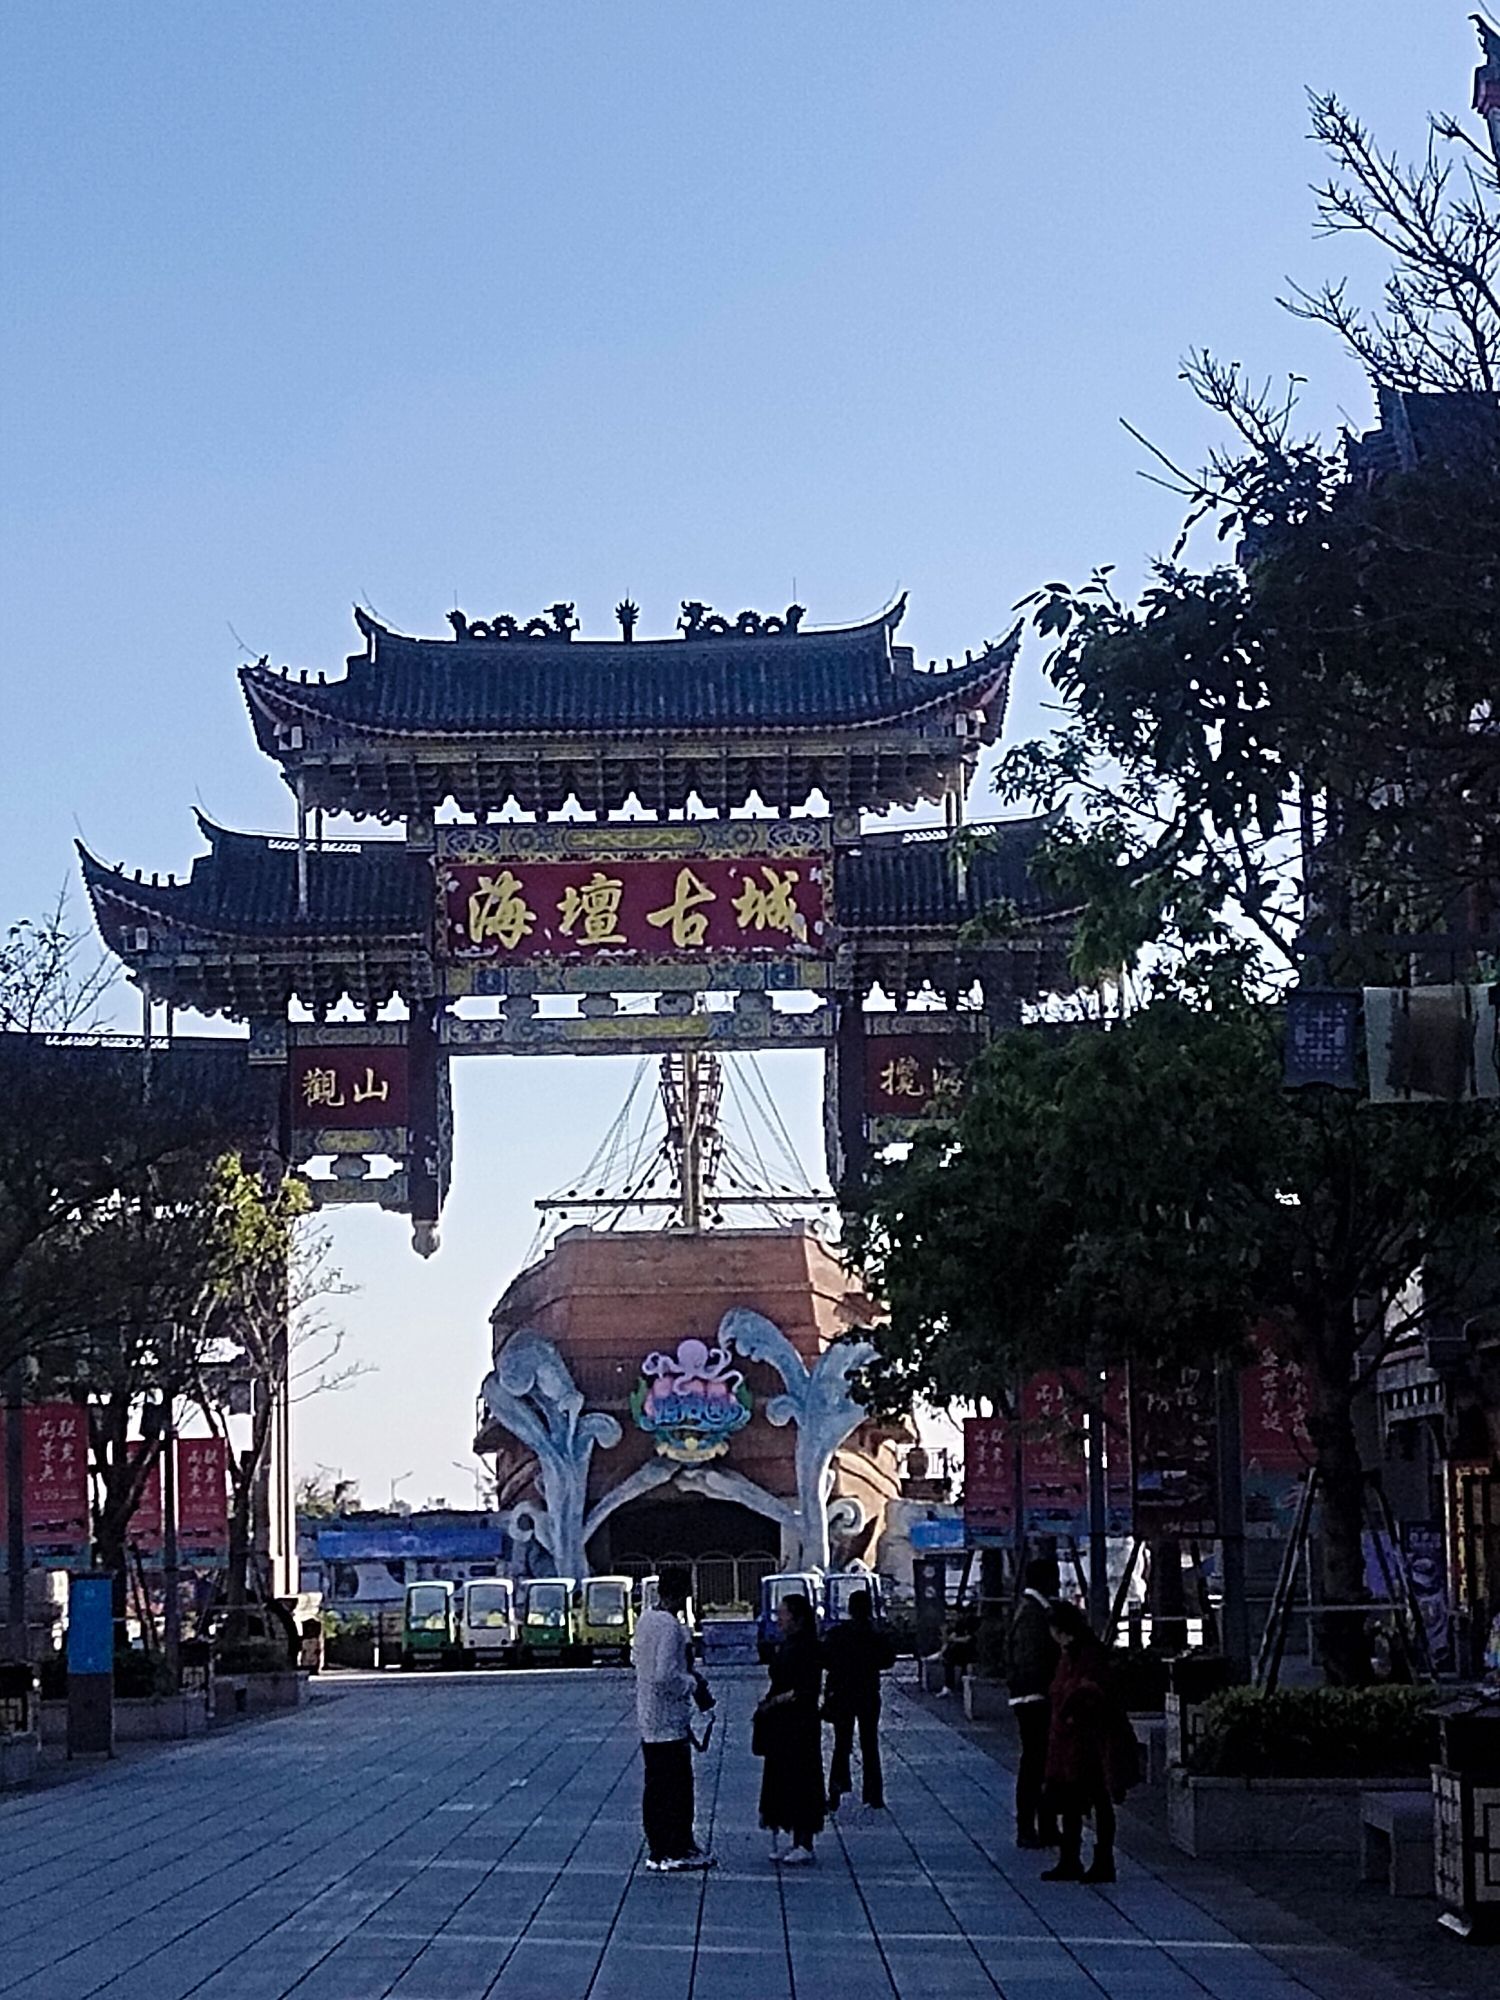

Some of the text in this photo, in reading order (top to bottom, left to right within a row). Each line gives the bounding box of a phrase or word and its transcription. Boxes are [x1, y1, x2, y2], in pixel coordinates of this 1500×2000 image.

[468, 866, 808, 949] 海壇古城
[302, 1066, 389, 1107] 觀山
